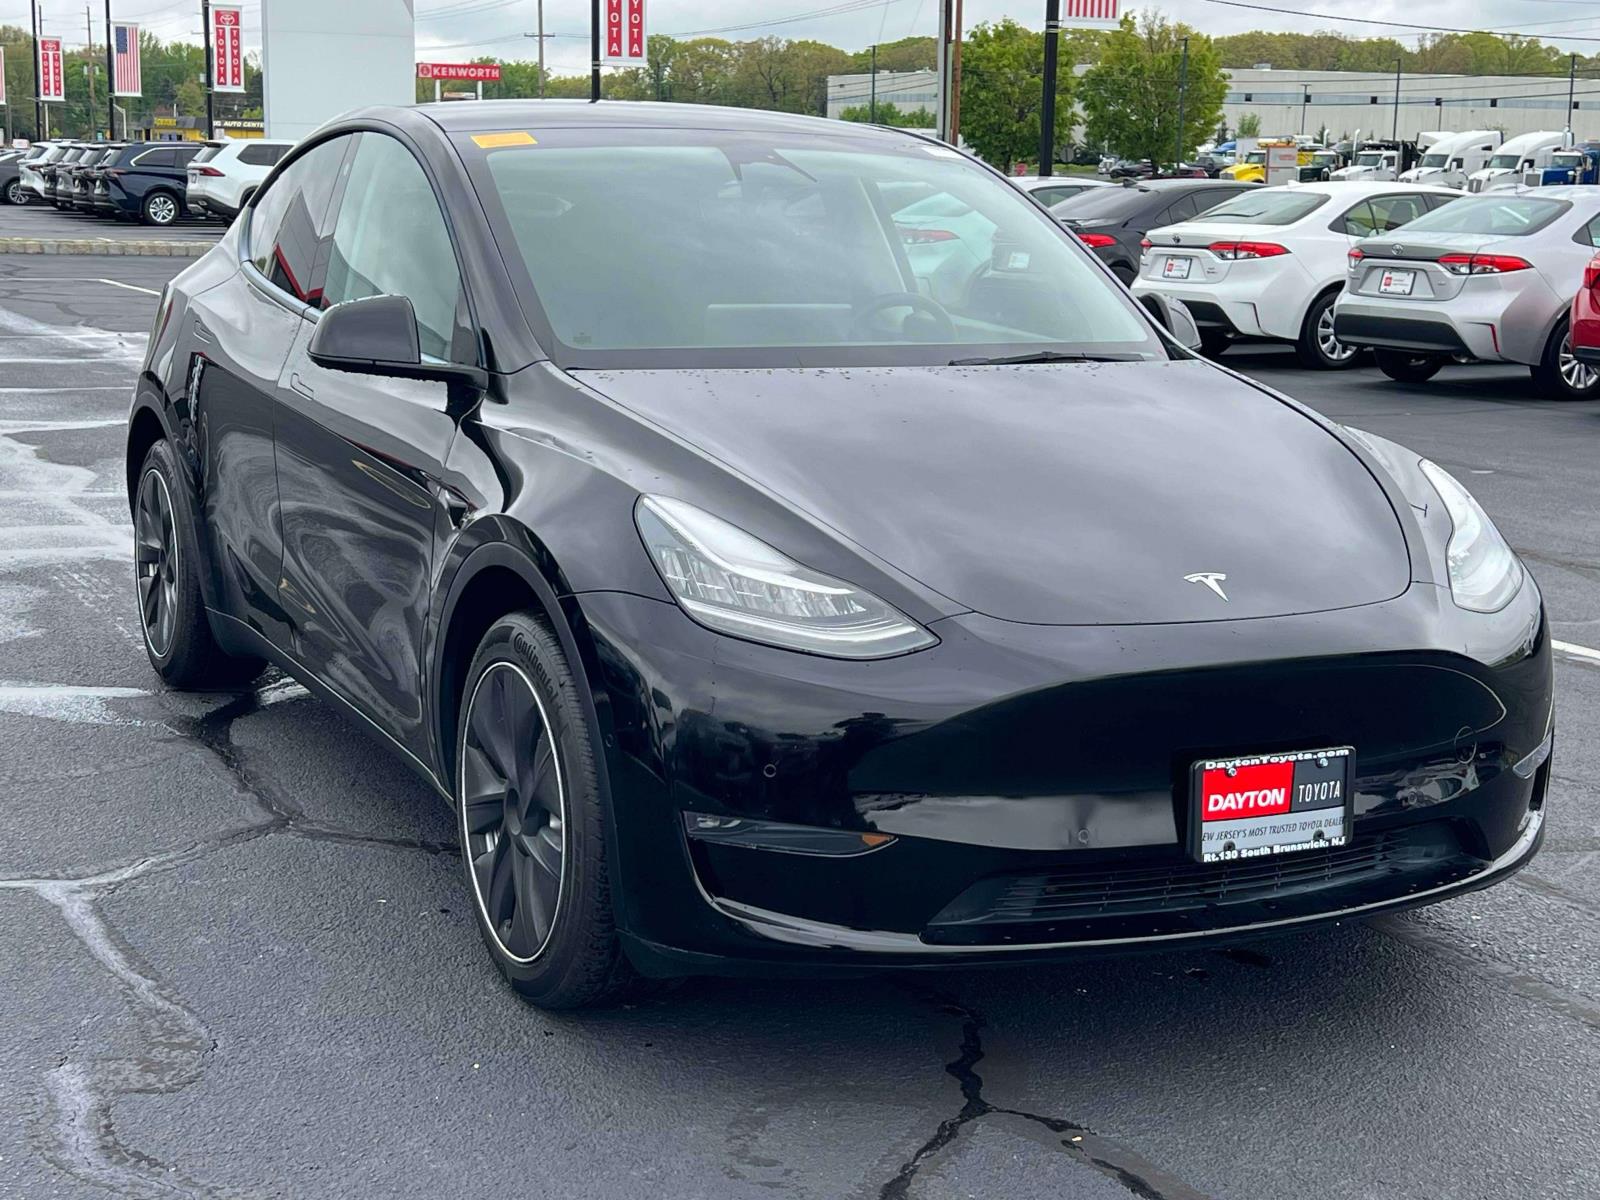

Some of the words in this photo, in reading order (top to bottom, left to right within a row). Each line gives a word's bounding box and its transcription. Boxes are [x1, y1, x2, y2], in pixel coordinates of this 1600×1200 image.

[217, 29, 225, 84] TOYOTA
[232, 29, 240, 85] TOYOTA
[432, 66, 500, 78] KENWORTH
[513, 632, 559, 703] Continental
[1205, 749, 1349, 769] DaytonToyota.com
[1208, 788, 1285, 812] DAYTON
[1298, 780, 1340, 803] TOYOTA
[1216, 829, 1248, 840] JERSEY'S
[1248, 826, 1268, 837] MOST
[1269, 822, 1298, 834] TRUSTED
[1298, 819, 1323, 831] TOYOTA
[1240, 845, 1271, 858] South
[1331, 836, 1346, 847] NJ
